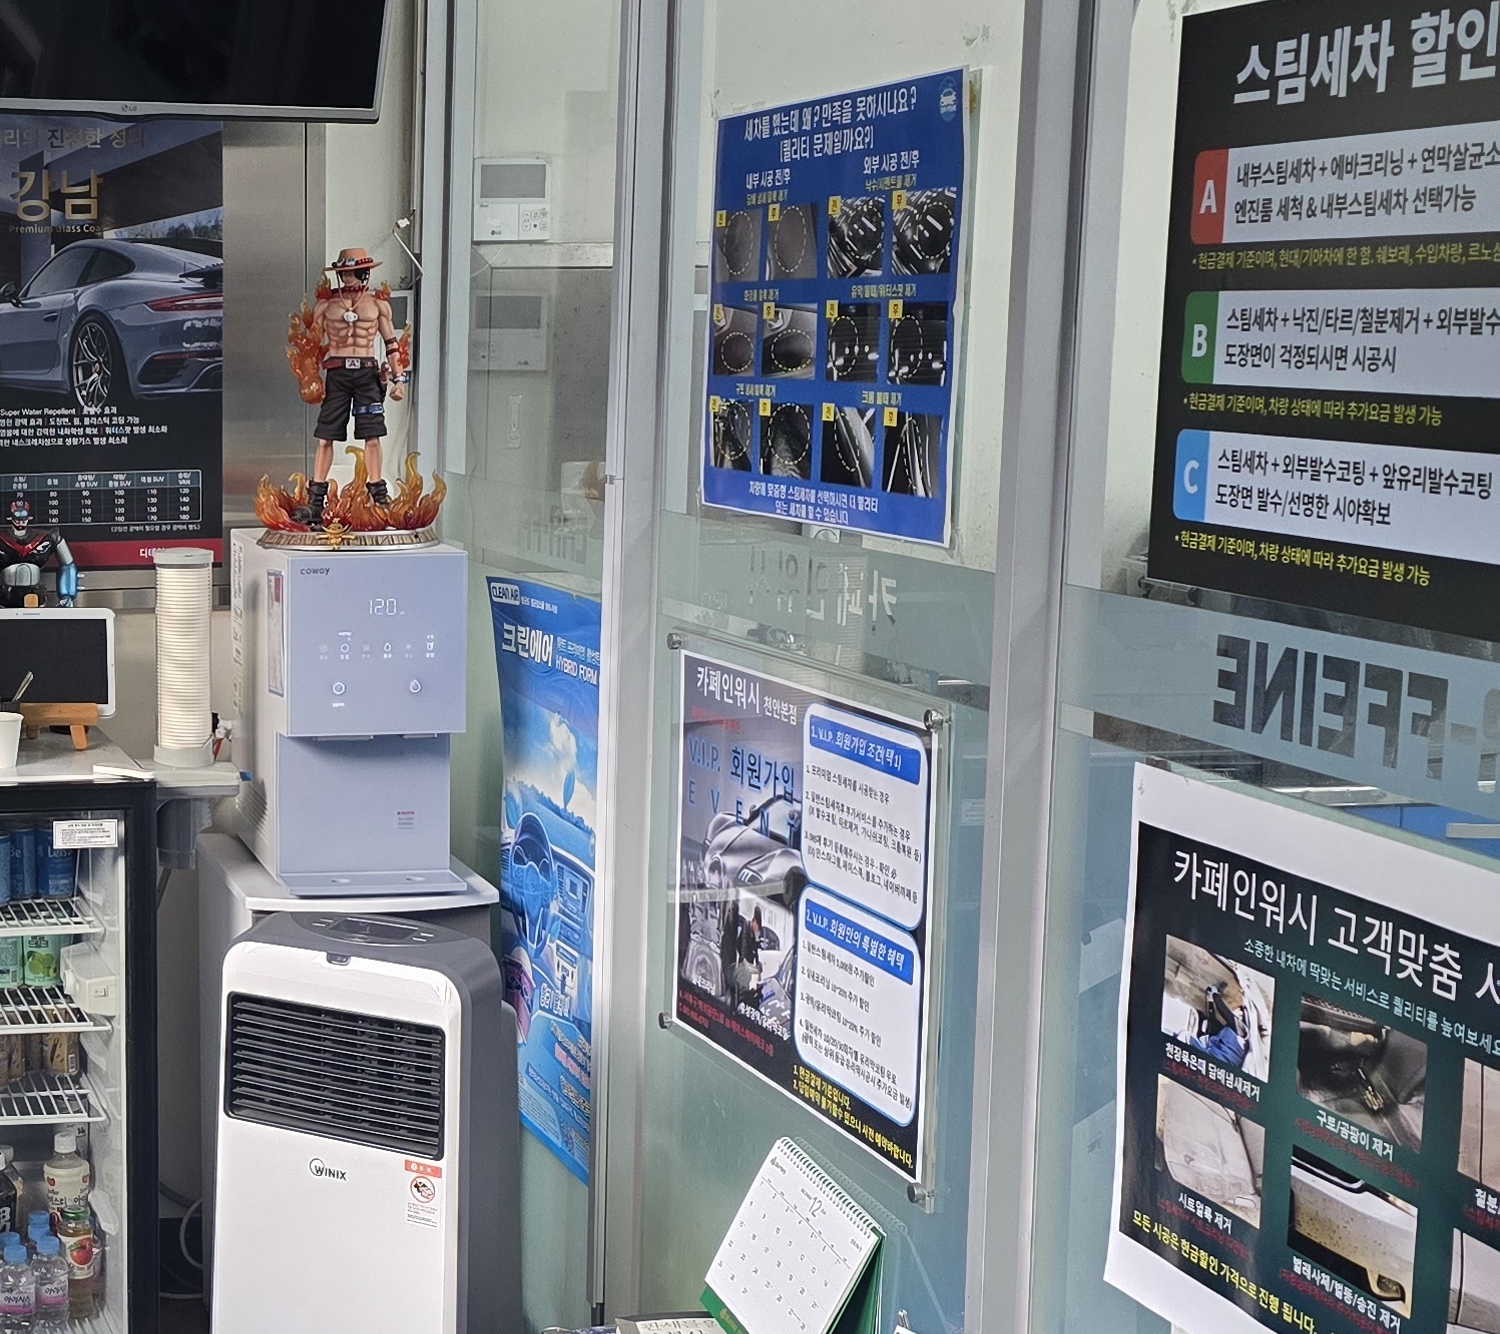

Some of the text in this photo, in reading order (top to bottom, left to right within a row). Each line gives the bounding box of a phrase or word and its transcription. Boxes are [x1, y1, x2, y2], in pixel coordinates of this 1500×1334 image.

[1234, 0, 1500, 105] 스팀세차 할인
[744, 117, 770, 141] 세차를
[1237, 156, 1317, 188] 내부스팀세차
[1331, 148, 1404, 181] 에바크리닝
[10, 169, 103, 221] 강남
[1200, 180, 1217, 214] A
[1234, 183, 1476, 224] 엔진룸 세척 & 내부스팀세차 선택가능
[1226, 307, 1278, 332] 스팀세차
[1192, 324, 1208, 357] B
[1224, 343, 1397, 373] 도장면이 걱정되시면 시공시
[0, 407, 76, 417] Super Water Repellent
[1184, 460, 1199, 494] C
[1218, 448, 1493, 499] 스팀세차 외부발수코팅 앞유리발수코팅
[1215, 484, 1391, 526] 도장면 발수/선명한 시야확보
[300, 567, 331, 575] coway
[1259, 543, 1279, 563] 차량
[1313, 551, 1334, 570] 따라
[1336, 555, 1379, 578] 추가요금
[1382, 561, 1404, 582] 발생
[1406, 565, 1430, 586] 가능
[369, 598, 397, 616] 120
[502, 622, 553, 667] 크린에어
[697, 666, 760, 714] 카페인워시
[730, 747, 794, 804] 회원가입
[1174, 850, 1462, 1001] 카페인워시 고객맞춤
[1244, 938, 1275, 964] 소중한
[1276, 949, 1308, 978] 내차에
[1309, 961, 1343, 992] 딱맞는
[1343, 974, 1390, 1010] 서비스로
[1392, 996, 1439, 1032] 퀄리티를
[1372, 1134, 1394, 1161] 제거
[311, 1161, 347, 1182] WINIX
[808, 1197, 823, 1218] 12
[1214, 1210, 1232, 1235] 제거
[1133, 1210, 1151, 1233] 모든
[1152, 1220, 1180, 1254] 시공은
[1180, 1235, 1218, 1276] 현금할인
[1220, 1256, 1257, 1300] 가격으로
[1259, 1286, 1279, 1314] 진행
